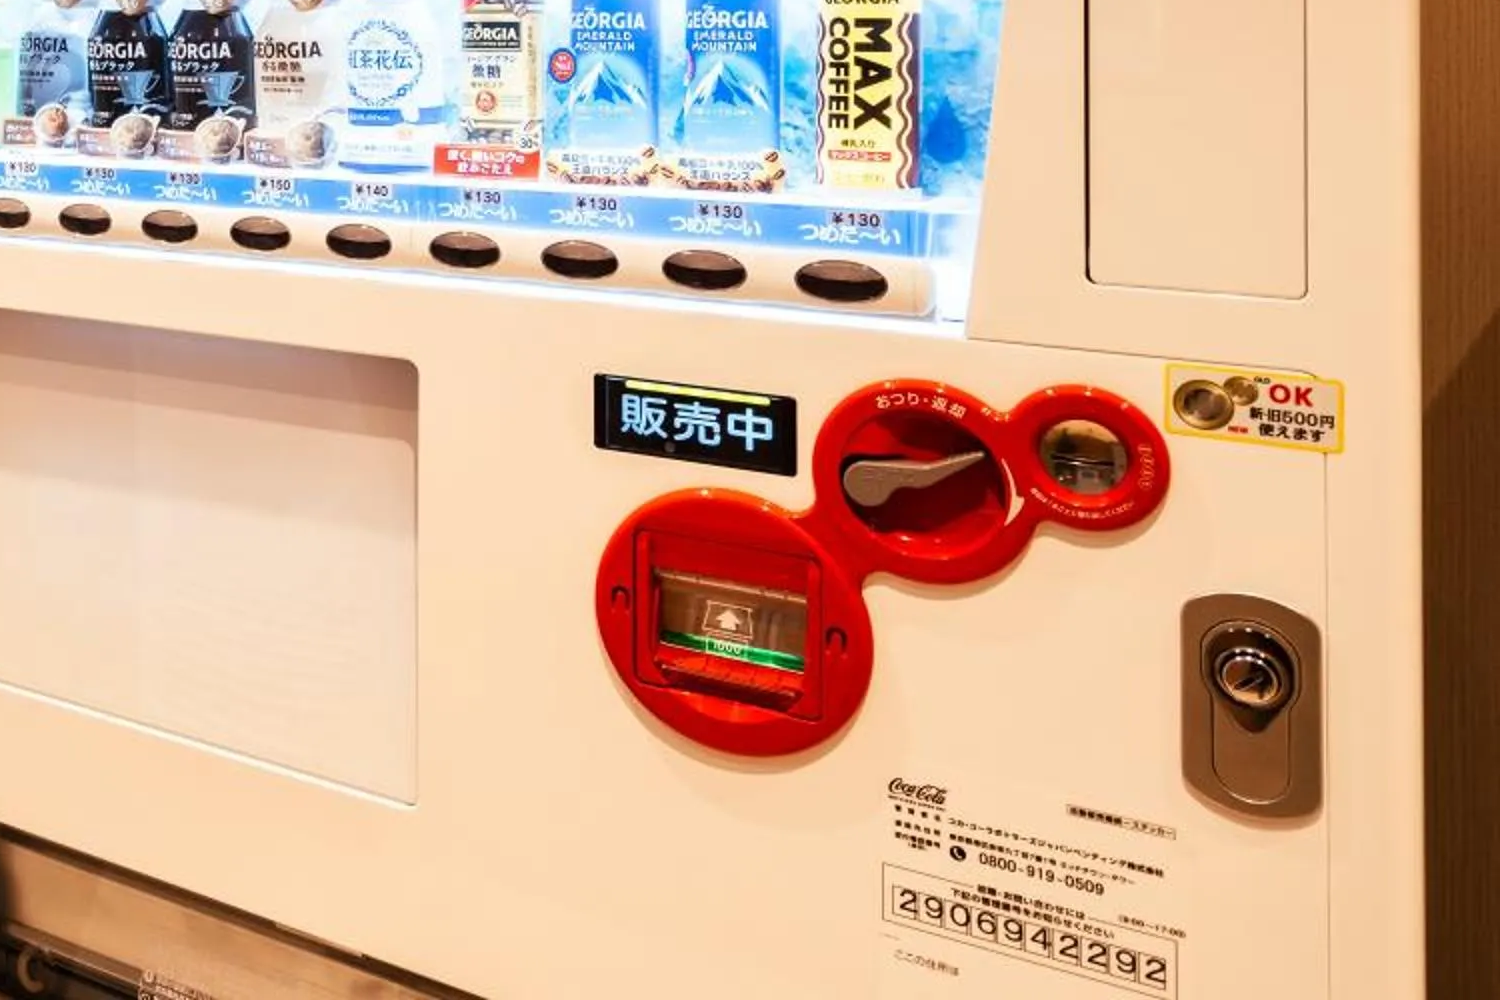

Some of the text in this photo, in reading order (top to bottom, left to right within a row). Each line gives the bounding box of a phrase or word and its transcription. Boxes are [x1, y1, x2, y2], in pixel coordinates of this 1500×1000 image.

[693, 31, 755, 41] EMERALD
[691, 41, 757, 52] MOUNTAIN
[828, 17, 851, 129] COFFEE
[854, 18, 893, 131] MAX
[85, 167, 114, 179] ¥130
[169, 172, 200, 185] ¥130
[260, 178, 291, 192] ¥150
[355, 184, 389, 198] ¥140
[464, 190, 501, 205] ¥130
[576, 197, 617, 212] ¥130
[698, 204, 743, 220] ¥130
[832, 212, 881, 228] ¥130
[1269, 383, 1313, 408] OK
[619, 392, 775, 453] 販売中
[1258, 423, 1327, 444] 使えます
[978, 851, 1106, 897] 0800-919-0509
[898, 887, 1168, 985] 2906942292
